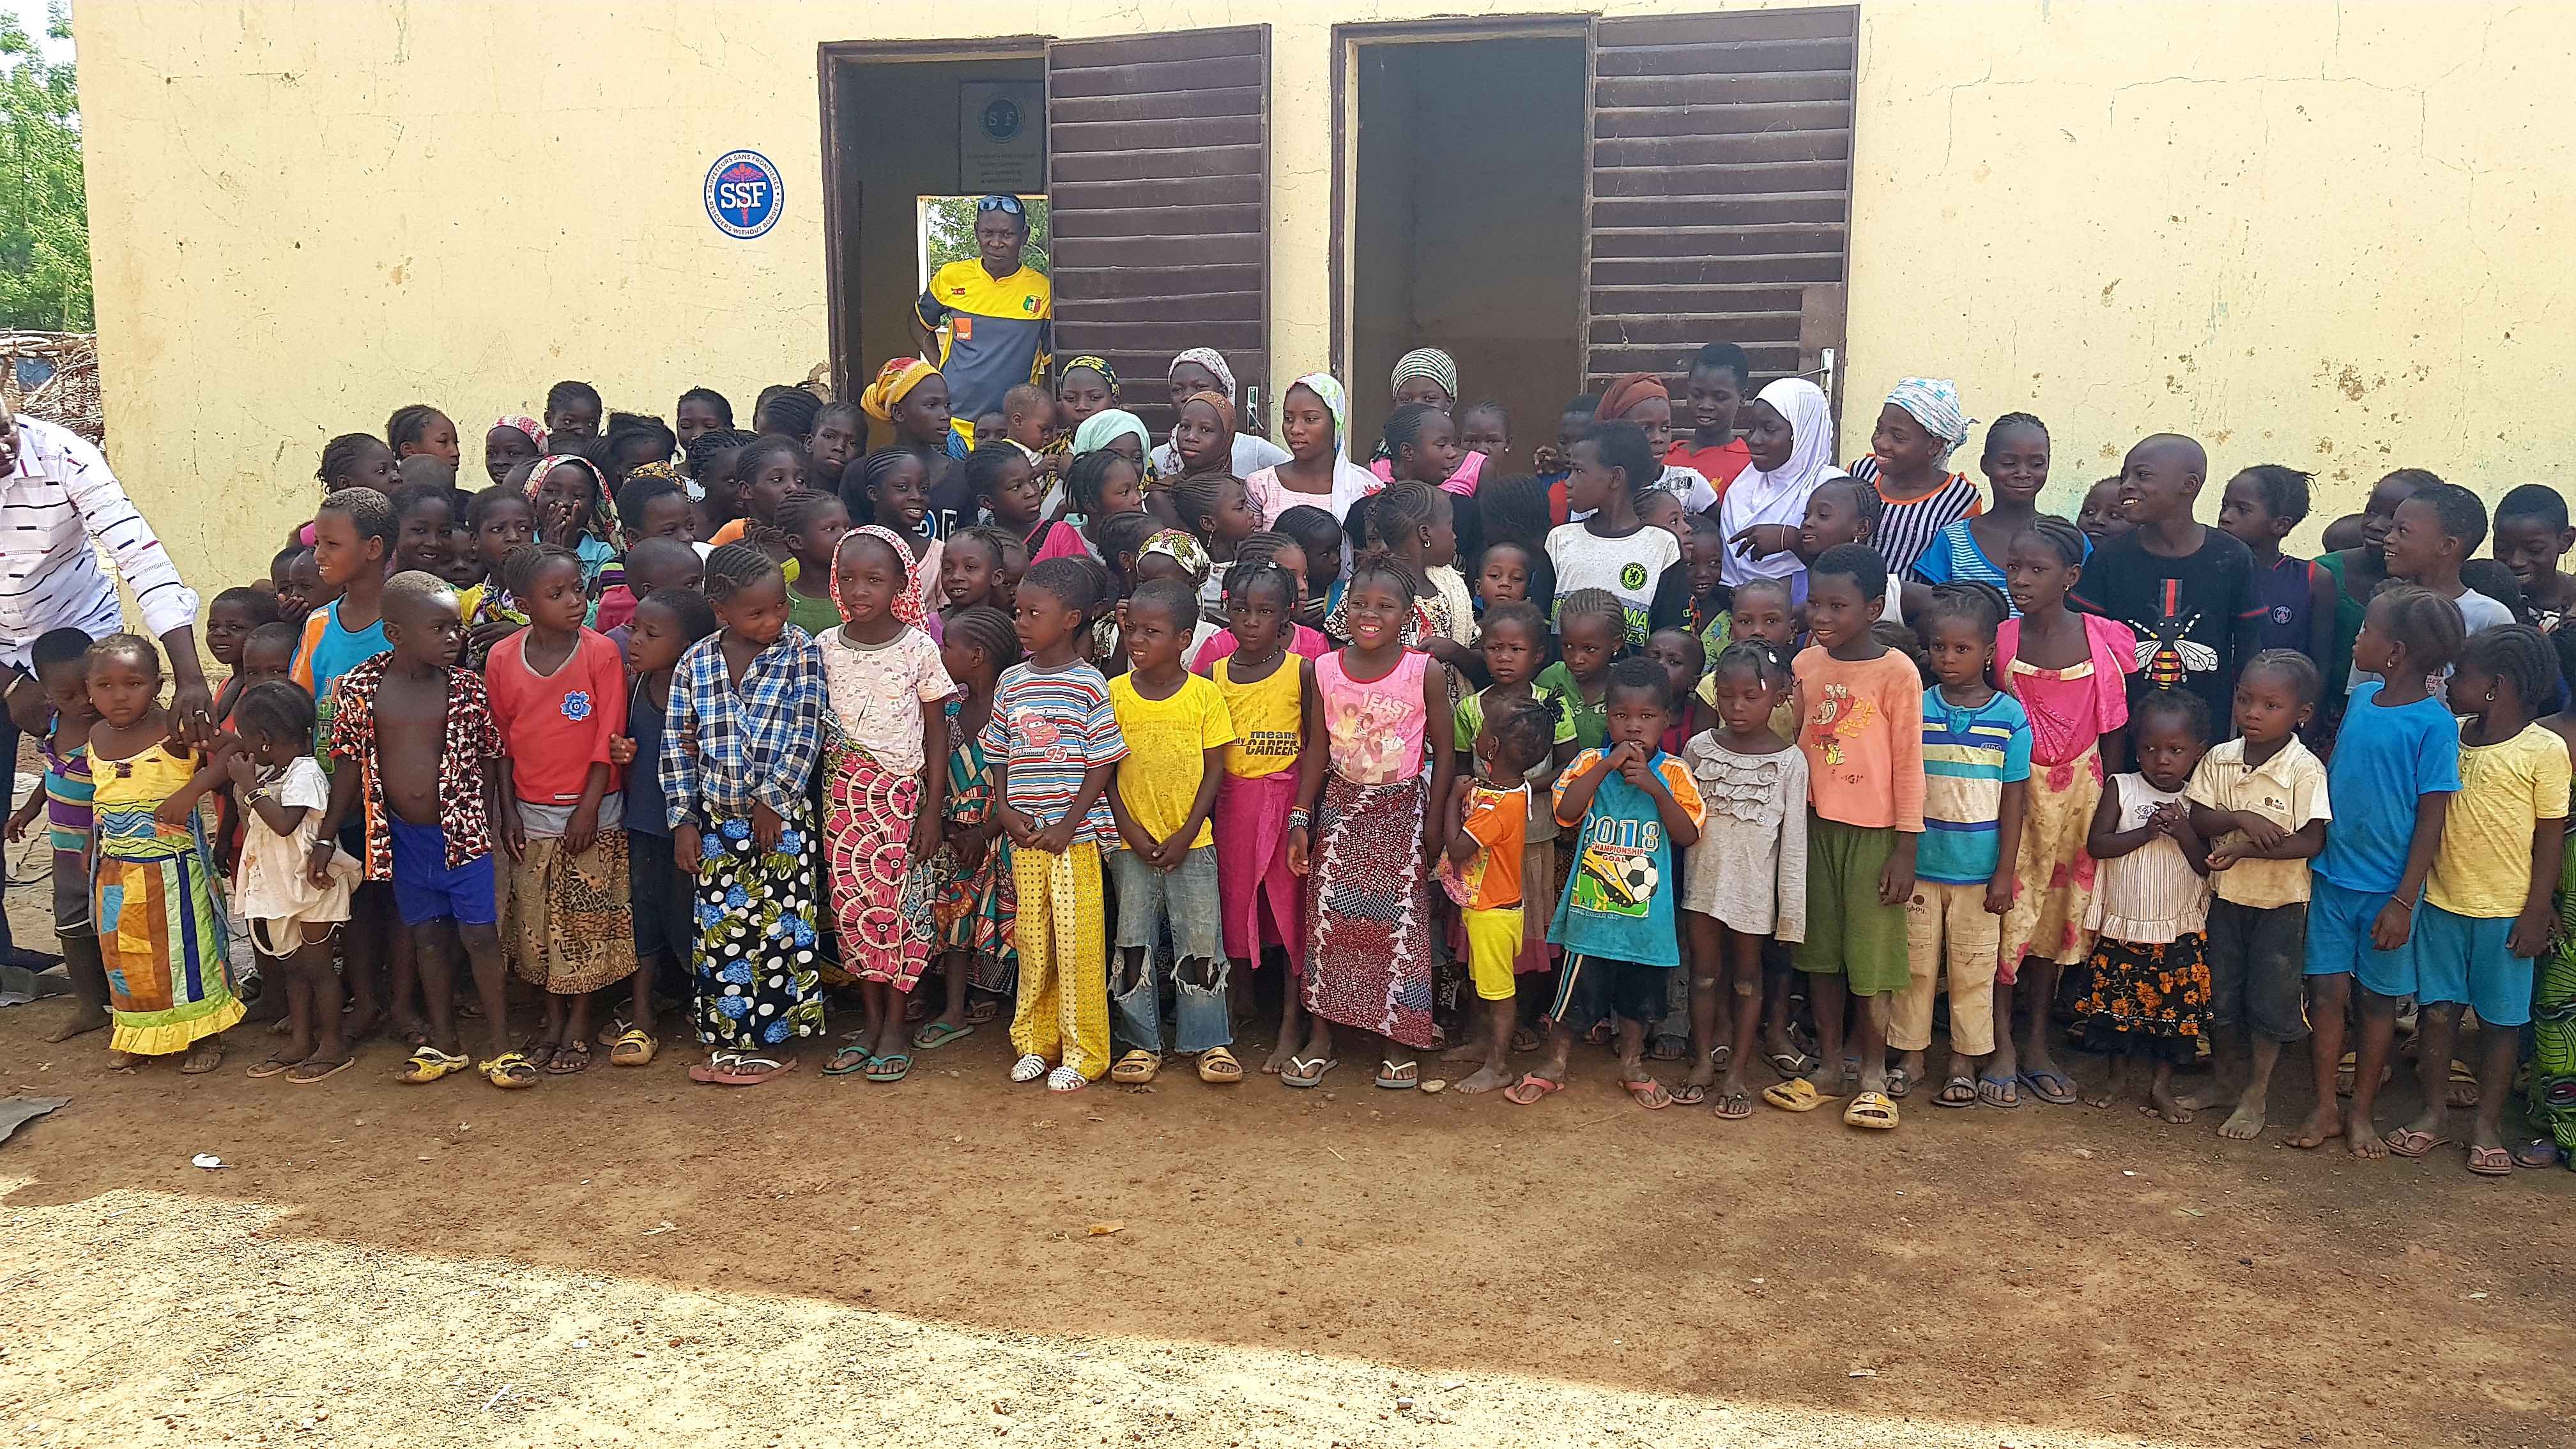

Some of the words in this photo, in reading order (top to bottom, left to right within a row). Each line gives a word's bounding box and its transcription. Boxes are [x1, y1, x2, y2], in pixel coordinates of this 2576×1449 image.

[988, 112, 1018, 126] SF
[707, 157, 733, 193] SAUVETEURS
[720, 181, 767, 210] SSF
[709, 201, 732, 231] RESCUERS
[733, 226, 763, 235] WITHOUT
[762, 198, 780, 229] BORDERS
[1368, 691, 1416, 723] EAST
[1250, 731, 1296, 740] means
[1046, 747, 1066, 761] 95
[1246, 739, 1300, 756] CAREERS
[1590, 841, 1646, 856] CHAMPIONSHIP
[1602, 854, 1627, 864] GOAL
